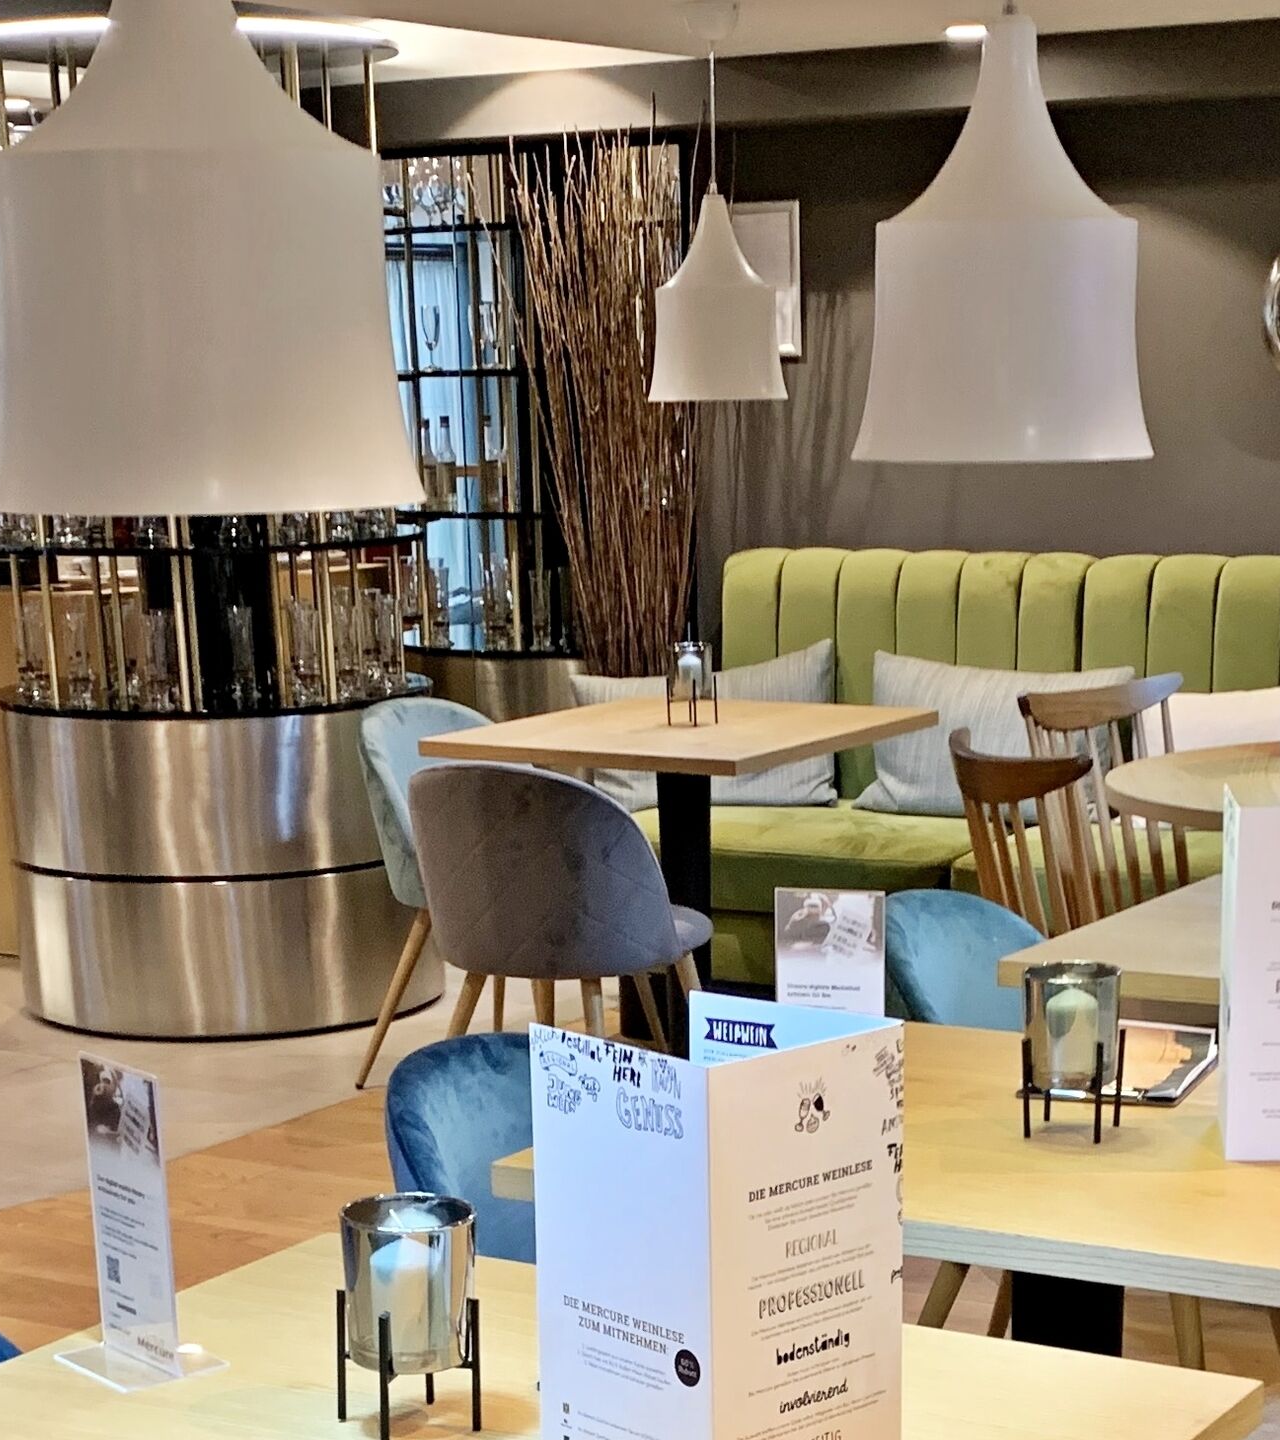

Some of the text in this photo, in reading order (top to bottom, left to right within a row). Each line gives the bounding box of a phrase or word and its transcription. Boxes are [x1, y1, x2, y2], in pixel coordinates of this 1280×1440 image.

[616, 1086, 685, 1140] GENUSS
[748, 1159, 874, 1203] DIE MERCURE WEINLESE
[785, 1228, 839, 1259] REGIONAL
[758, 1268, 866, 1320] PROFESSIONELL
[563, 1294, 686, 1345] DIE MERCURE WEINLESE
[578, 1315, 601, 1334] ZUM
[775, 1328, 851, 1366] bodenständig
[779, 1376, 849, 1414] involvierend
